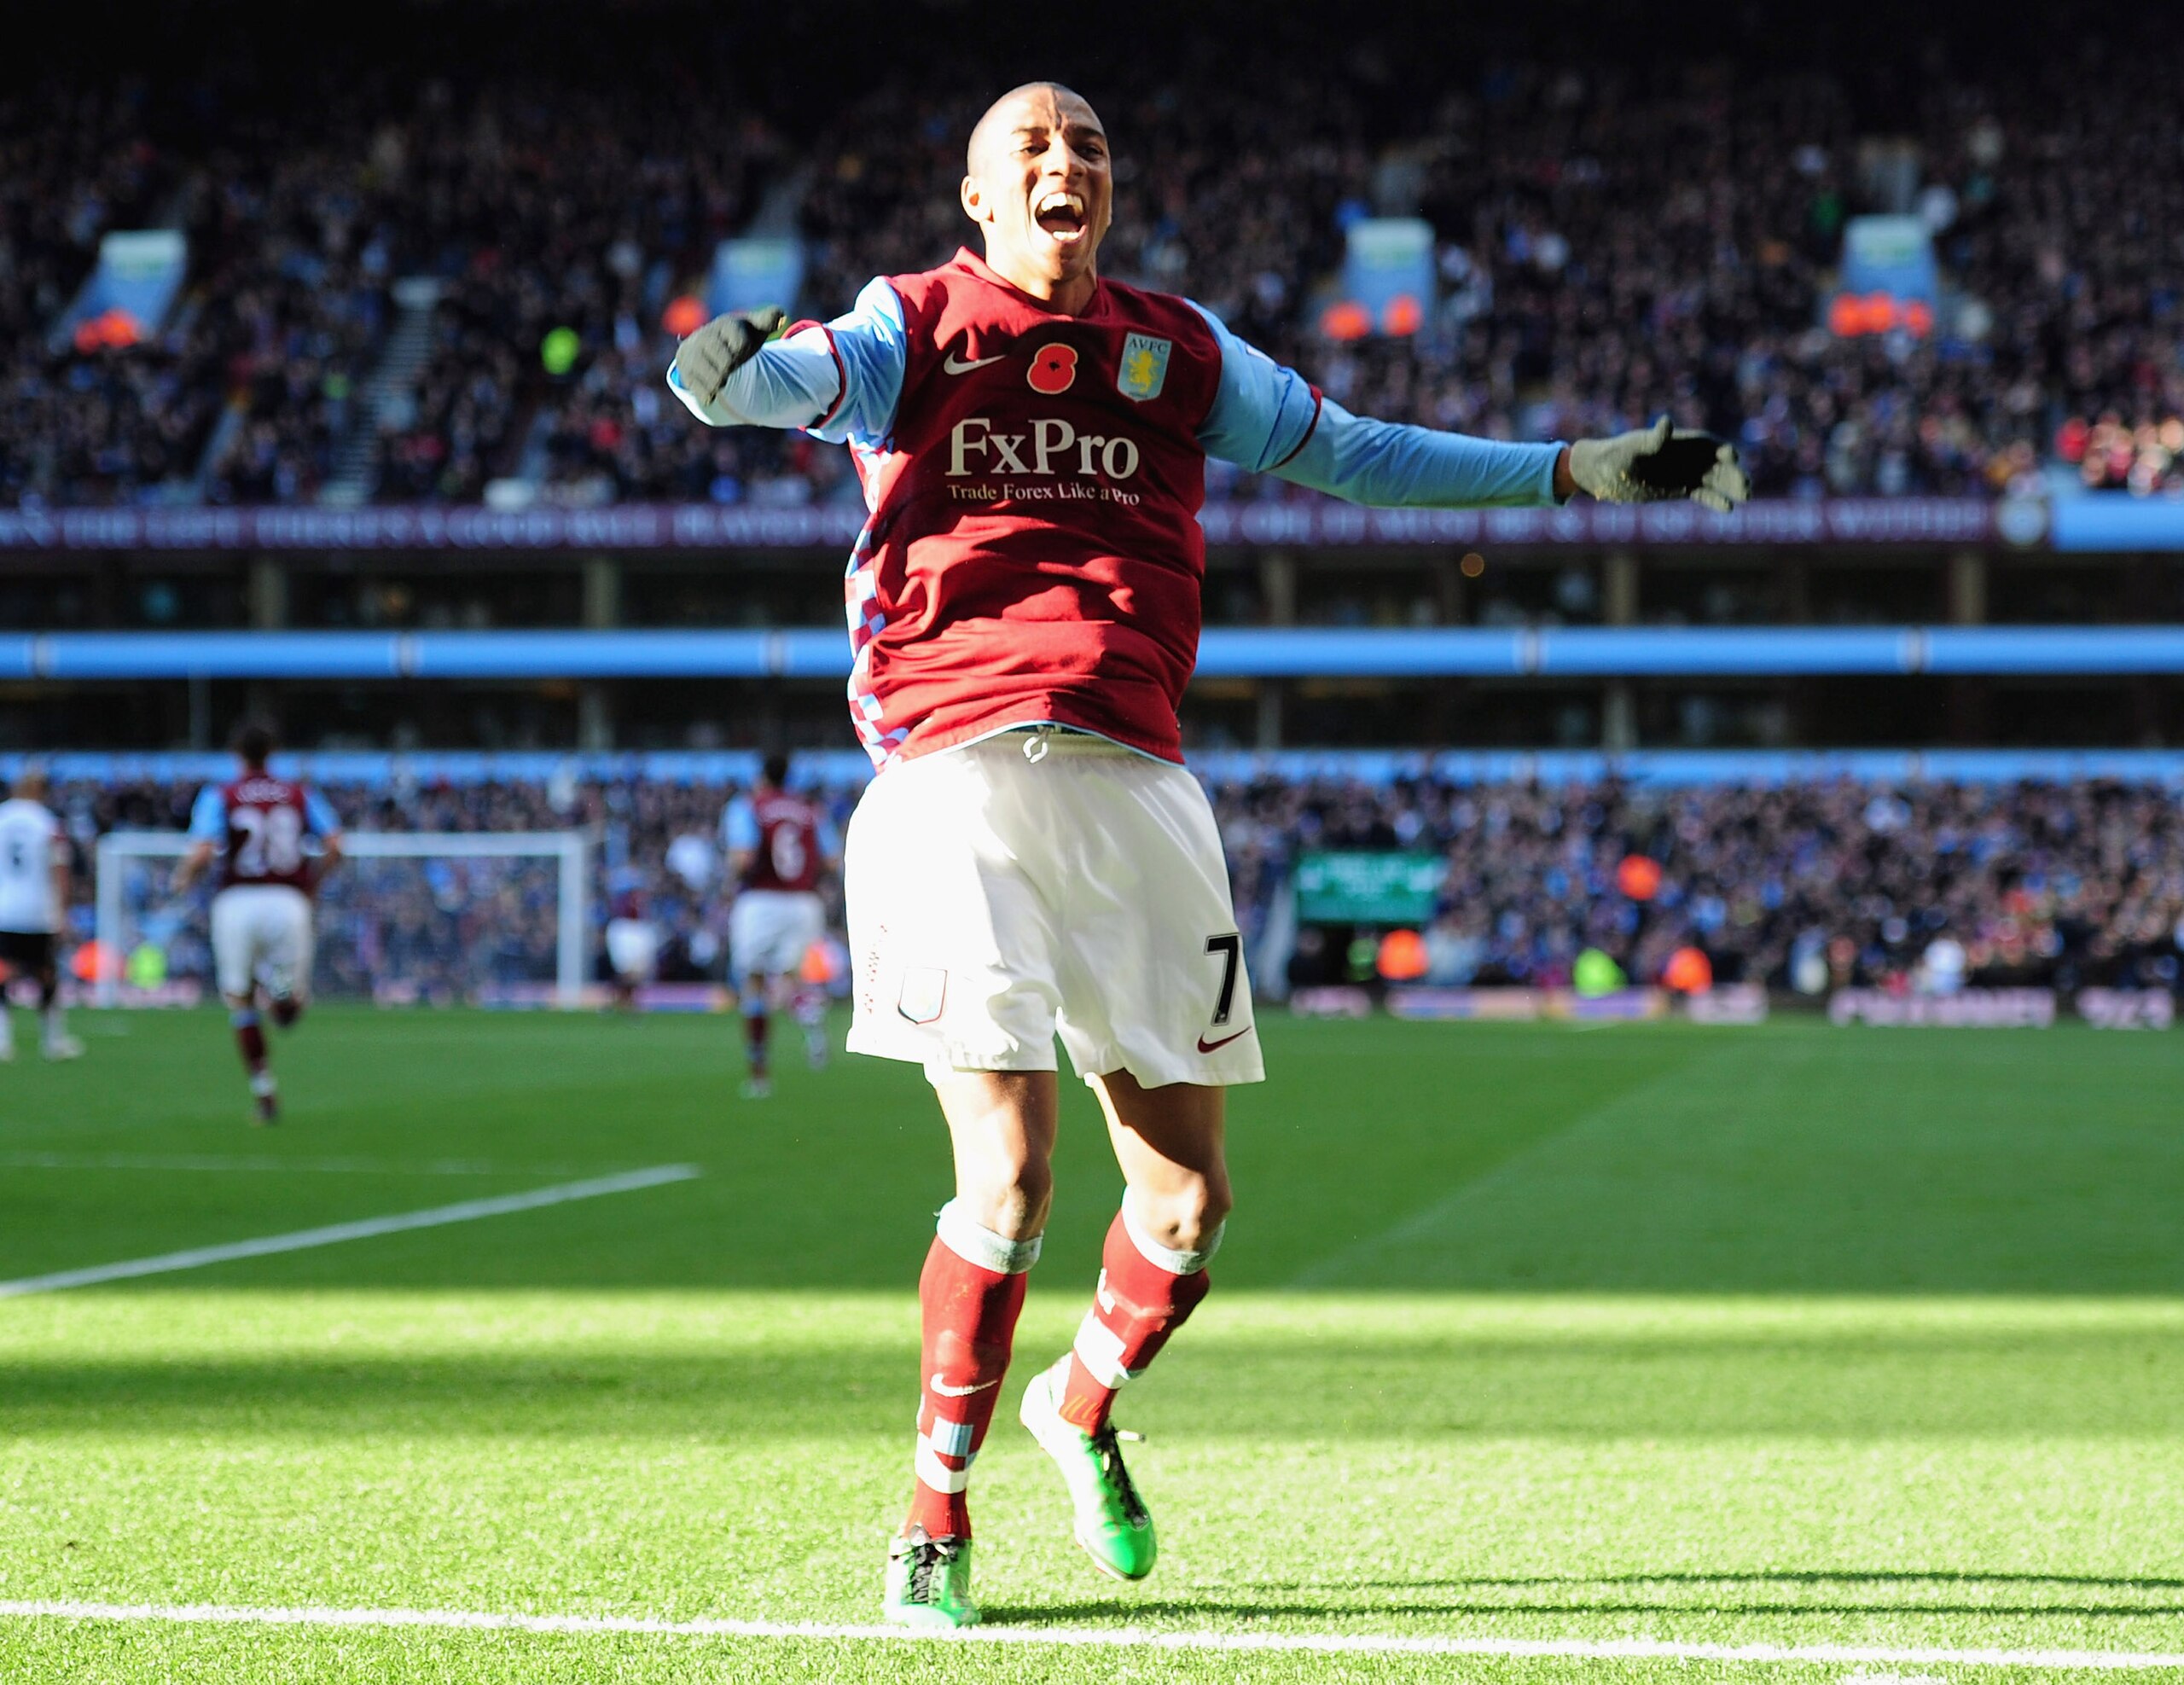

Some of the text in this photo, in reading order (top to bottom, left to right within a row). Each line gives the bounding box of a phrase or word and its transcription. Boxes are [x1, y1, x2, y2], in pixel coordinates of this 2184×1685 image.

[1129, 338, 1168, 354] AVFC
[944, 417, 1140, 479] FxPro
[947, 482, 1141, 506] Trade Forex Like a Pro
[1203, 932, 1242, 1027] 7
